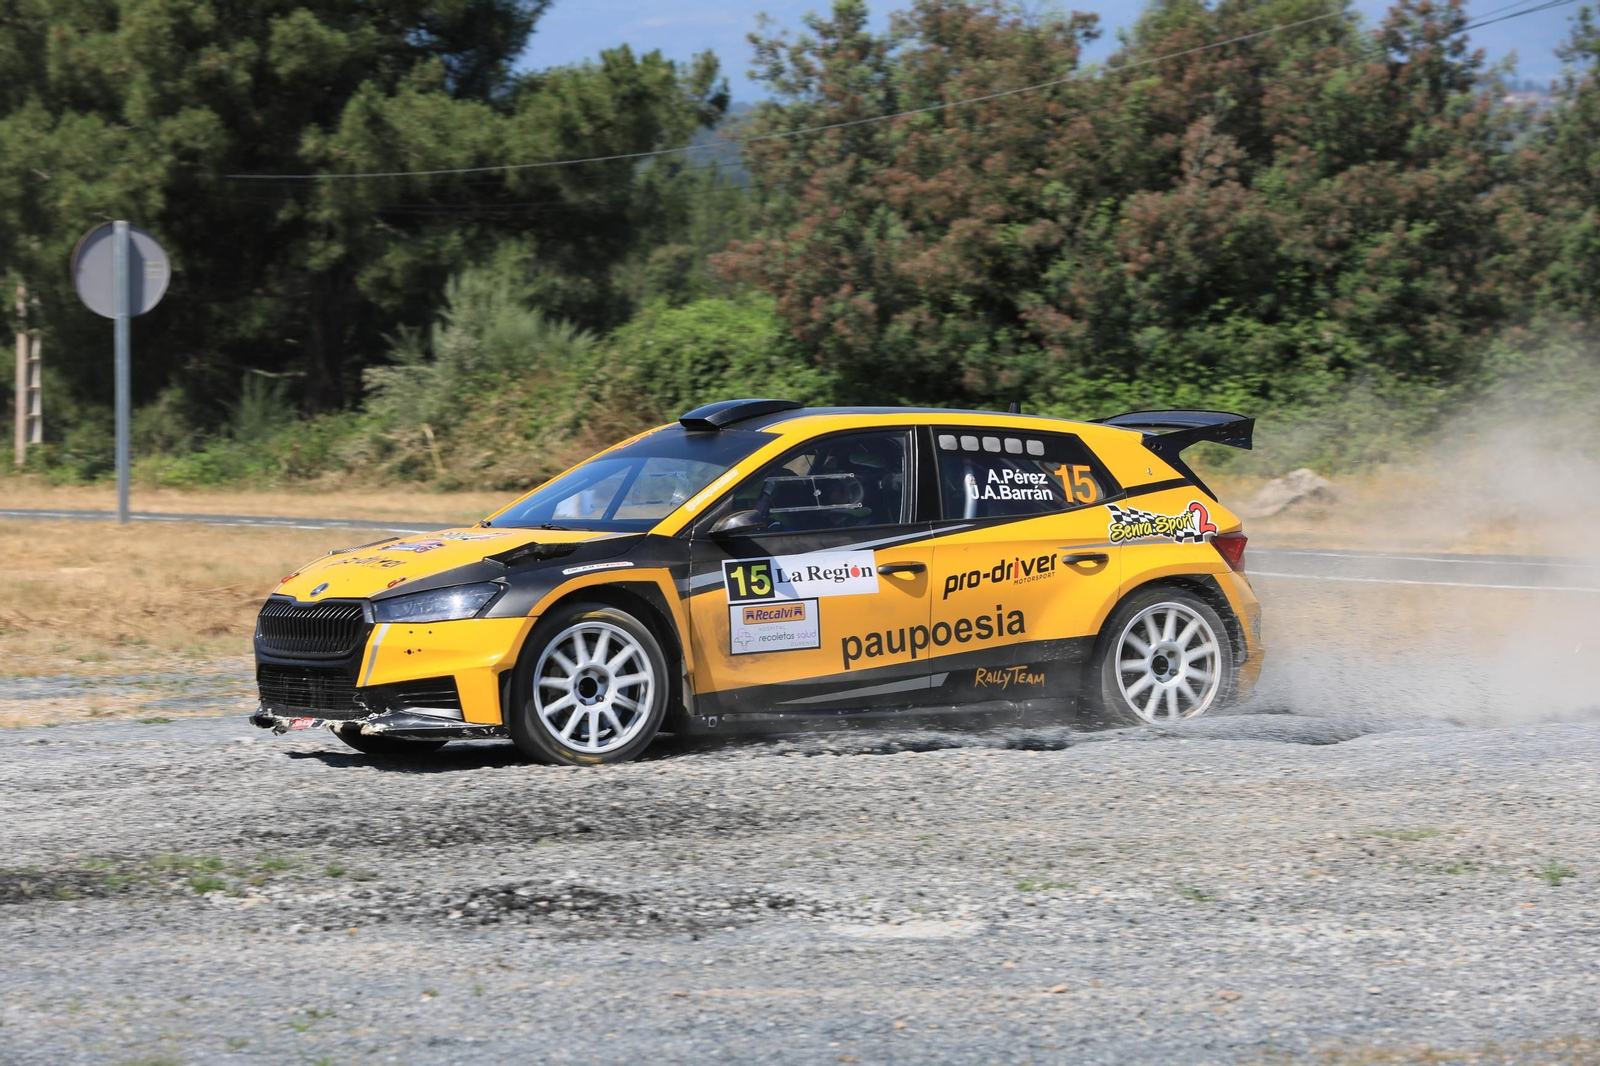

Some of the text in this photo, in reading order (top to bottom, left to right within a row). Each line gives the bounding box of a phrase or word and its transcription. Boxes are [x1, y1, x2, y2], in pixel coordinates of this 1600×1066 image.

[987, 469, 1048, 485] A.Pérez
[1054, 464, 1097, 504] 15
[971, 484, 1053, 501] J.A.Barrán
[1110, 522, 1153, 543] Senra
[1154, 510, 1196, 536] Sport
[730, 564, 771, 597] 15
[775, 563, 873, 584] La Región
[943, 553, 1057, 600] pro-driver
[1013, 571, 1056, 586] MOTORSPORT
[755, 606, 794, 621] Recalvi
[758, 629, 817, 643] recoletas salud
[841, 604, 1026, 670] paupoesia
